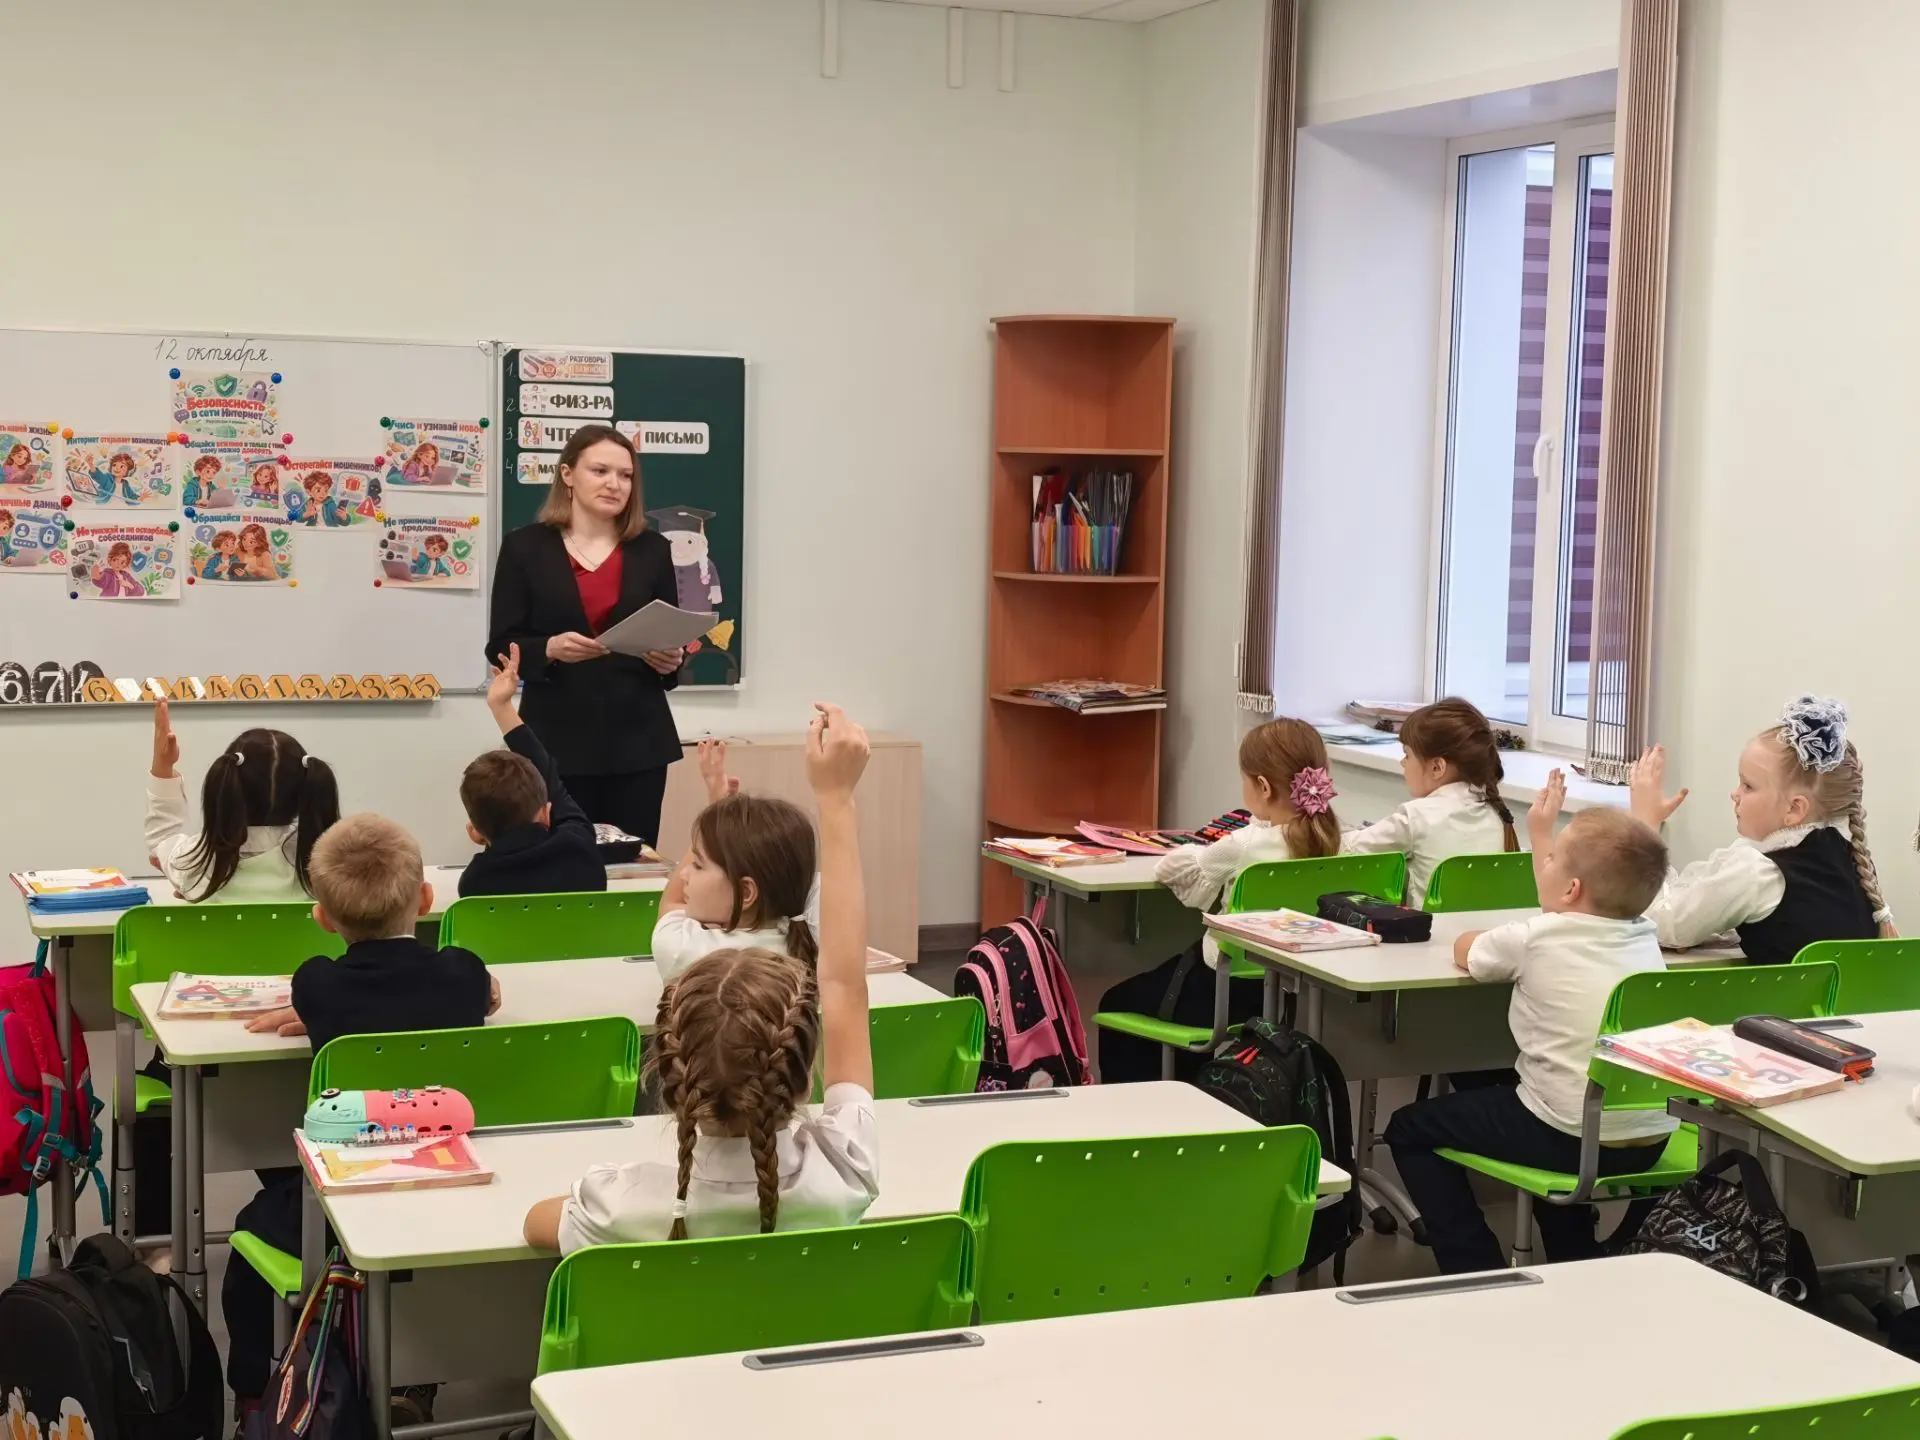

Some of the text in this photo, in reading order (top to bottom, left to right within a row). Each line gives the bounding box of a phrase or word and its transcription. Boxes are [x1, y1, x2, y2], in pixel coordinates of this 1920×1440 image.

[155, 339, 273, 372] 12 октября.
[569, 355, 607, 363] РАЗГОВОРЫ
[186, 397, 266, 412] Безопасность
[550, 393, 613, 410] ФИЗ-РА
[191, 407, 263, 419] в сети Интернет
[28, 426, 56, 436] жизн
[386, 419, 415, 431] Учись
[423, 422, 458, 431] узнавай
[458, 424, 484, 434] новое
[66, 436, 171, 446] Интернет открывает возможности
[184, 440, 215, 449] Общайся
[644, 431, 704, 445] ПИСЬМО
[241, 447, 273, 455] доверять
[284, 459, 332, 471] Остерегайся
[192, 512, 293, 526] Обращайся за помощью
[384, 517, 473, 530] Не принимай опасные
[76, 527, 90, 538] Не
[90, 525, 119, 536] унижай
[402, 525, 457, 534] предложения
[98, 533, 154, 542] собеседников
[0, 669, 24, 703] 6
[38, 671, 61, 703] 7
[88, 680, 107, 702] 6
[240, 677, 259, 699] 6
[274, 678, 287, 698] 1
[300, 678, 321, 699] 3
[334, 677, 353, 699] 2
[362, 678, 382, 699] 3
[389, 677, 409, 699] 5
[415, 677, 436, 699] 5
